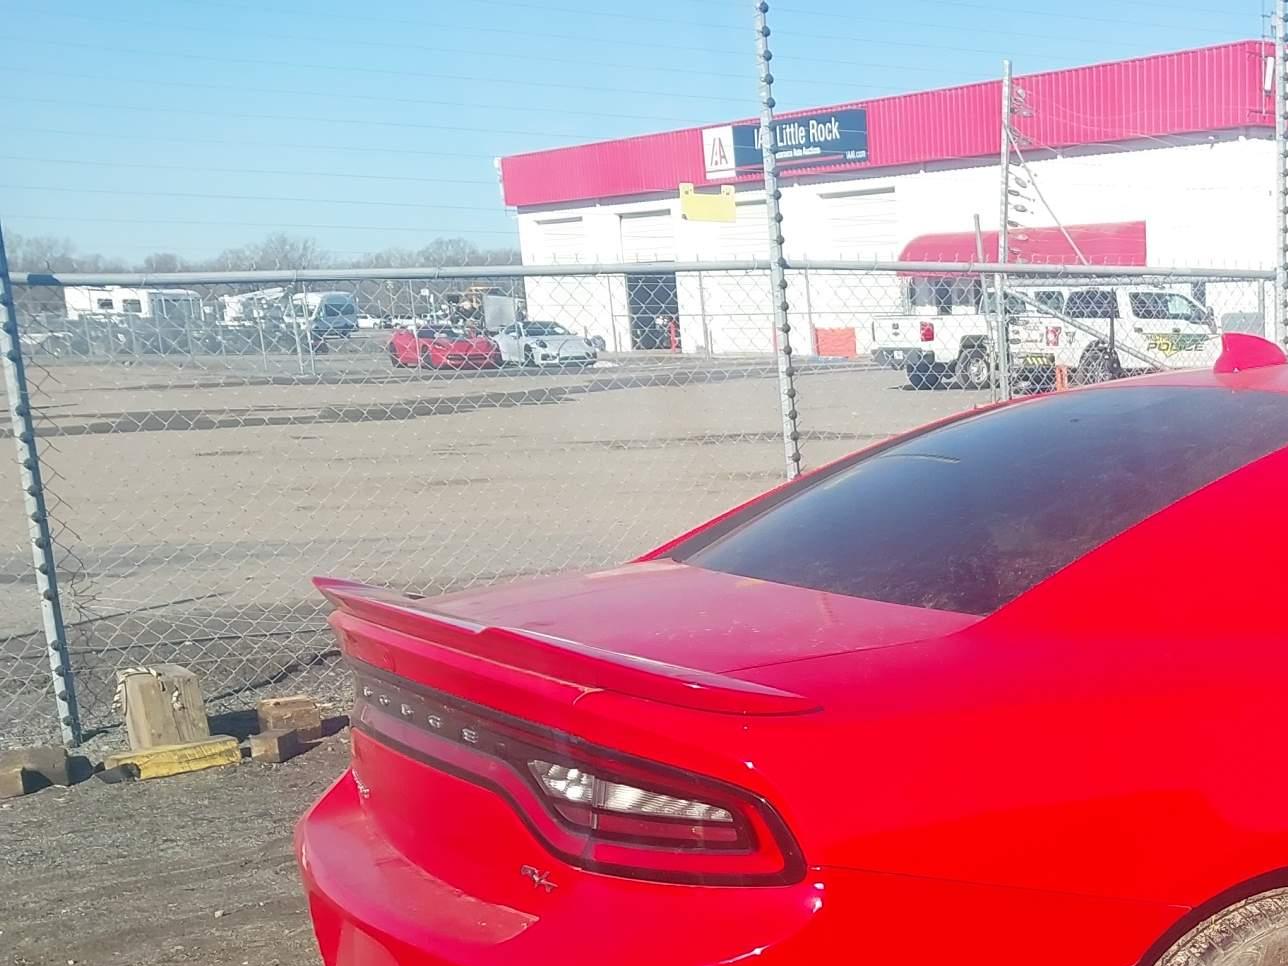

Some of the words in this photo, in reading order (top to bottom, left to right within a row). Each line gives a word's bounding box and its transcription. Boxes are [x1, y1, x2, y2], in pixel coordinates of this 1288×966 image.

[776, 122, 806, 147] Little
[809, 116, 841, 143] Rock
[1147, 342, 1205, 352] POLICE
[363, 685, 479, 744] DODGE
